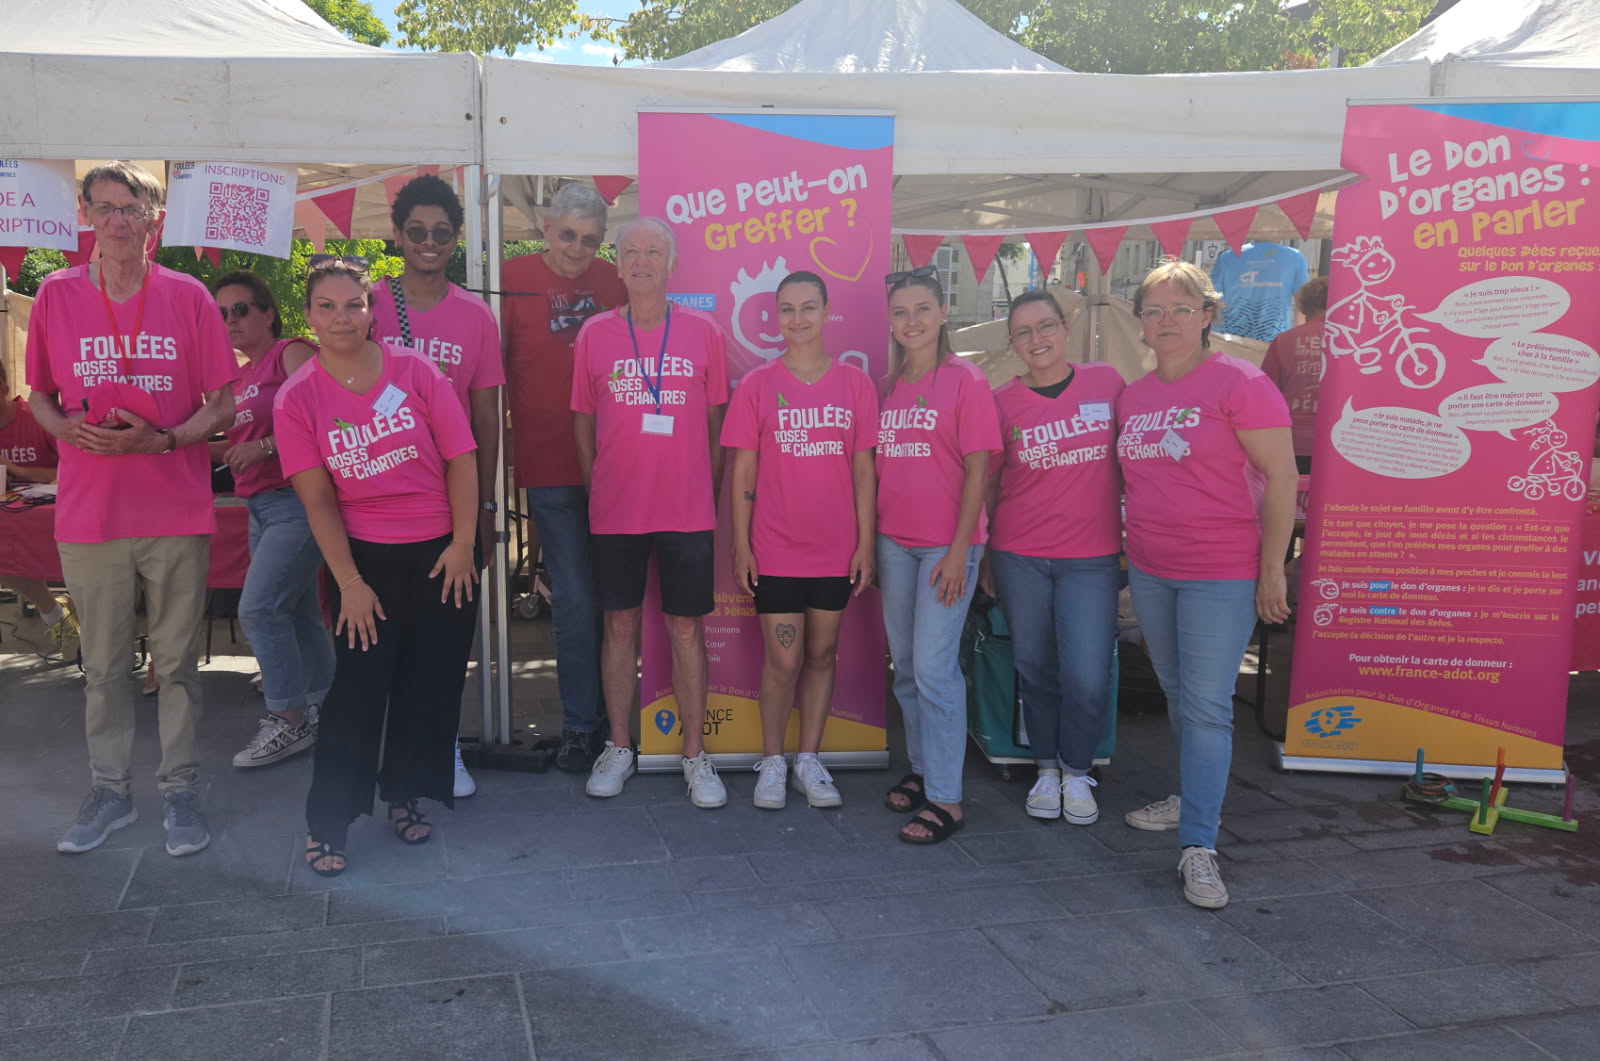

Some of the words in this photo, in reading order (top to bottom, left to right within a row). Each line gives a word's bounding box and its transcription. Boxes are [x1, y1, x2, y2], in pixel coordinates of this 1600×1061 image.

[1389, 149, 1432, 183] Le
[1444, 135, 1510, 170] Don
[205, 165, 285, 185] INSCRIPTIONS
[22, 192, 35, 207] A
[666, 188, 726, 224] Que
[736, 164, 867, 212] Peut-on
[1379, 164, 1565, 220] D'organes
[705, 207, 830, 251] Greffer
[840, 198, 857, 227] ?
[1414, 219, 1458, 249] en
[1472, 198, 1584, 241] Parler
[1458, 246, 1516, 258] Quelques
[1560, 246, 1600, 260] reçue
[1459, 262, 1482, 272] sur
[1486, 260, 1496, 271] le
[1478, 289, 1493, 297] suis
[1494, 288, 1509, 297] trop
[80, 331, 176, 360] FOULÉES
[1518, 350, 1533, 358] cher
[73, 360, 117, 377] ROSES
[614, 353, 694, 377] FOULÉES
[84, 376, 95, 387] DE
[615, 393, 624, 402] DE
[1448, 402, 1469, 410] porter
[778, 404, 852, 430] FOULÉES
[880, 404, 938, 430] OULÉES
[328, 406, 416, 454] FOULÉES
[782, 443, 791, 453] DE
[1018, 442, 1058, 463] ROSES
[1030, 460, 1041, 470] DE
[1042, 445, 1108, 470] CHARTRES
[327, 448, 368, 470] ROSES
[340, 467, 353, 479] DE
[353, 445, 418, 480] CHARTRES
[1391, 582, 1398, 590] le
[1401, 582, 1416, 590] don
[1419, 582, 1460, 592] d'organes
[1399, 607, 1406, 615] le
[1430, 608, 1471, 618] d'organes
[1349, 654, 1372, 662] Pour
[1374, 654, 1409, 664] obtenir
[1411, 656, 1420, 665] la
[1423, 657, 1448, 666] carte
[1451, 658, 1462, 666] de
[1465, 658, 1506, 668] donneur
[1359, 665, 1500, 683] www.france-adot.org
[1388, 694, 1405, 704] Don
[1451, 709, 1460, 717] et
[1461, 711, 1471, 720] de
[1474, 714, 1499, 727] Tissus
[1501, 721, 1537, 737] humains
